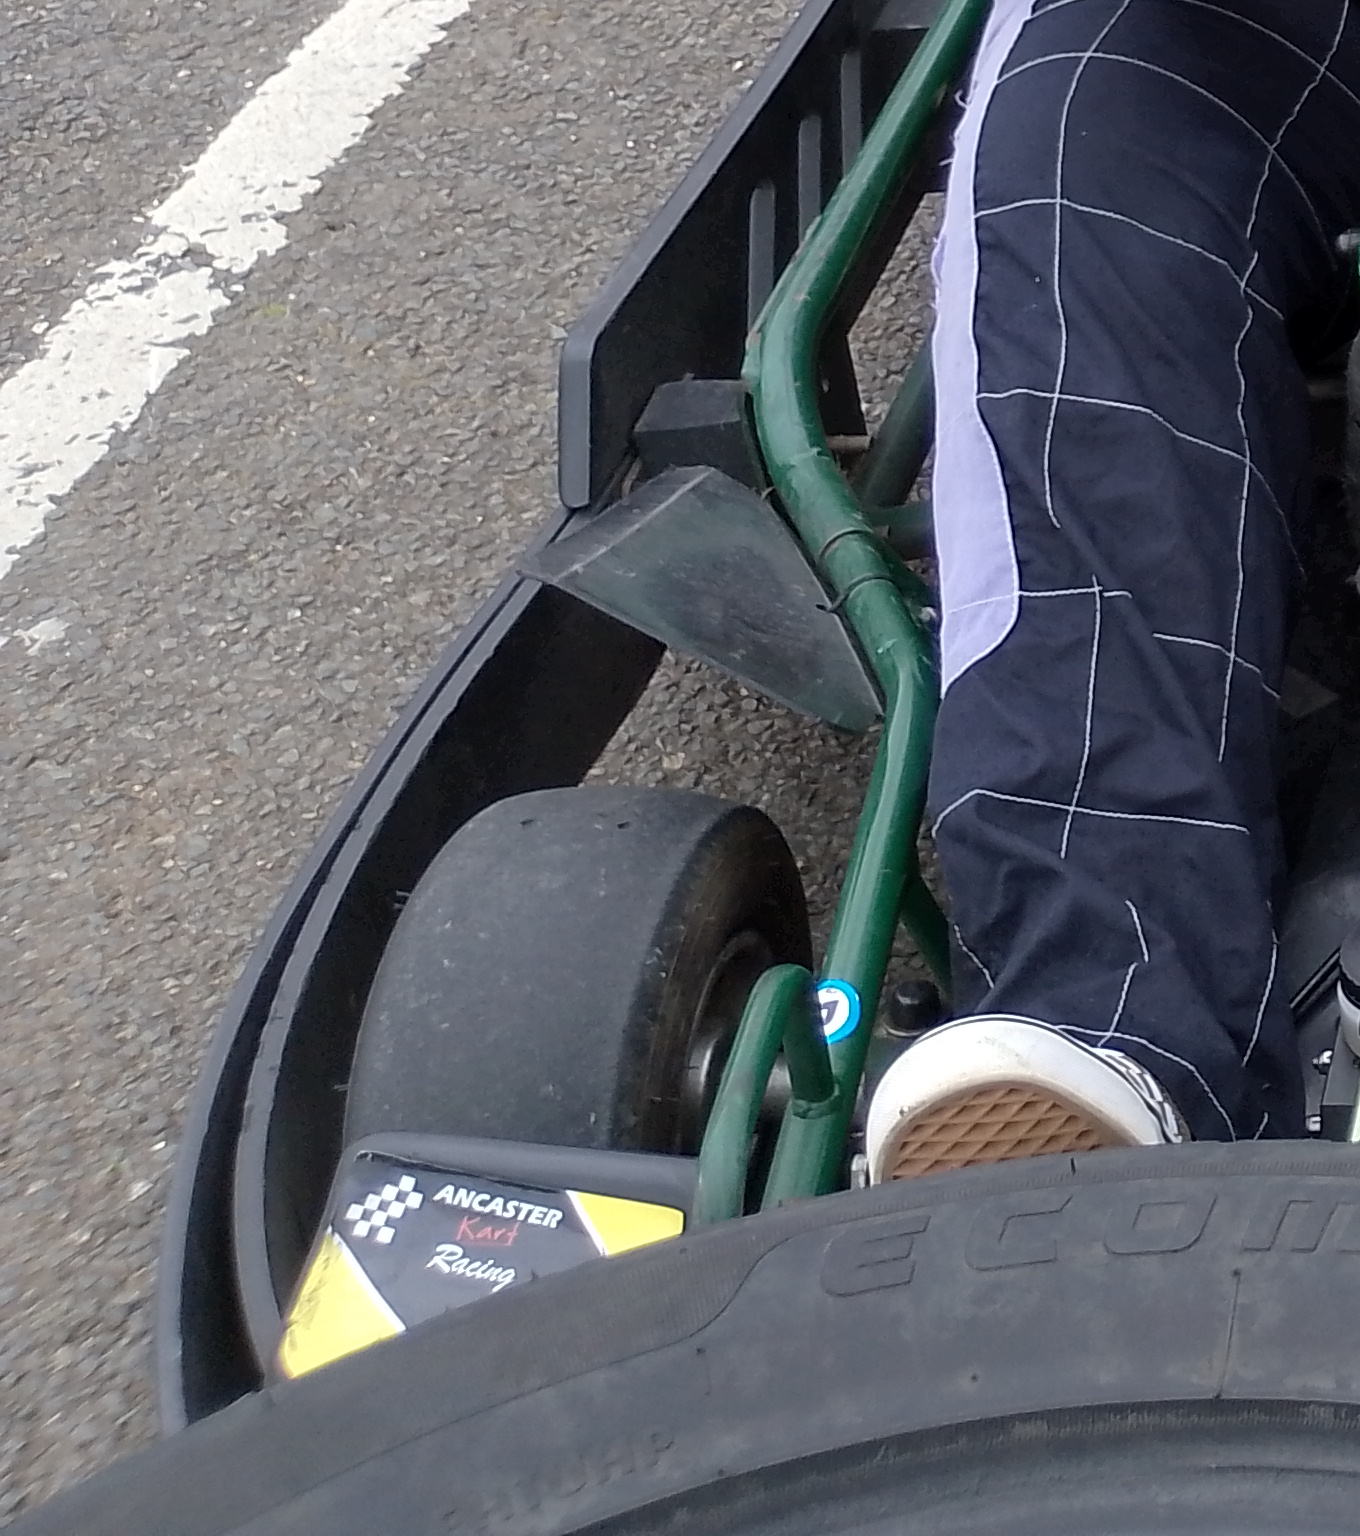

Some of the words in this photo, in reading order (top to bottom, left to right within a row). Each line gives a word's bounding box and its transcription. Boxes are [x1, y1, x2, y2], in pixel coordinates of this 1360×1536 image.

[432, 1183, 564, 1229] ANCASTER
[454, 1215, 520, 1247] Kart
[425, 1242, 517, 1293] Racing
